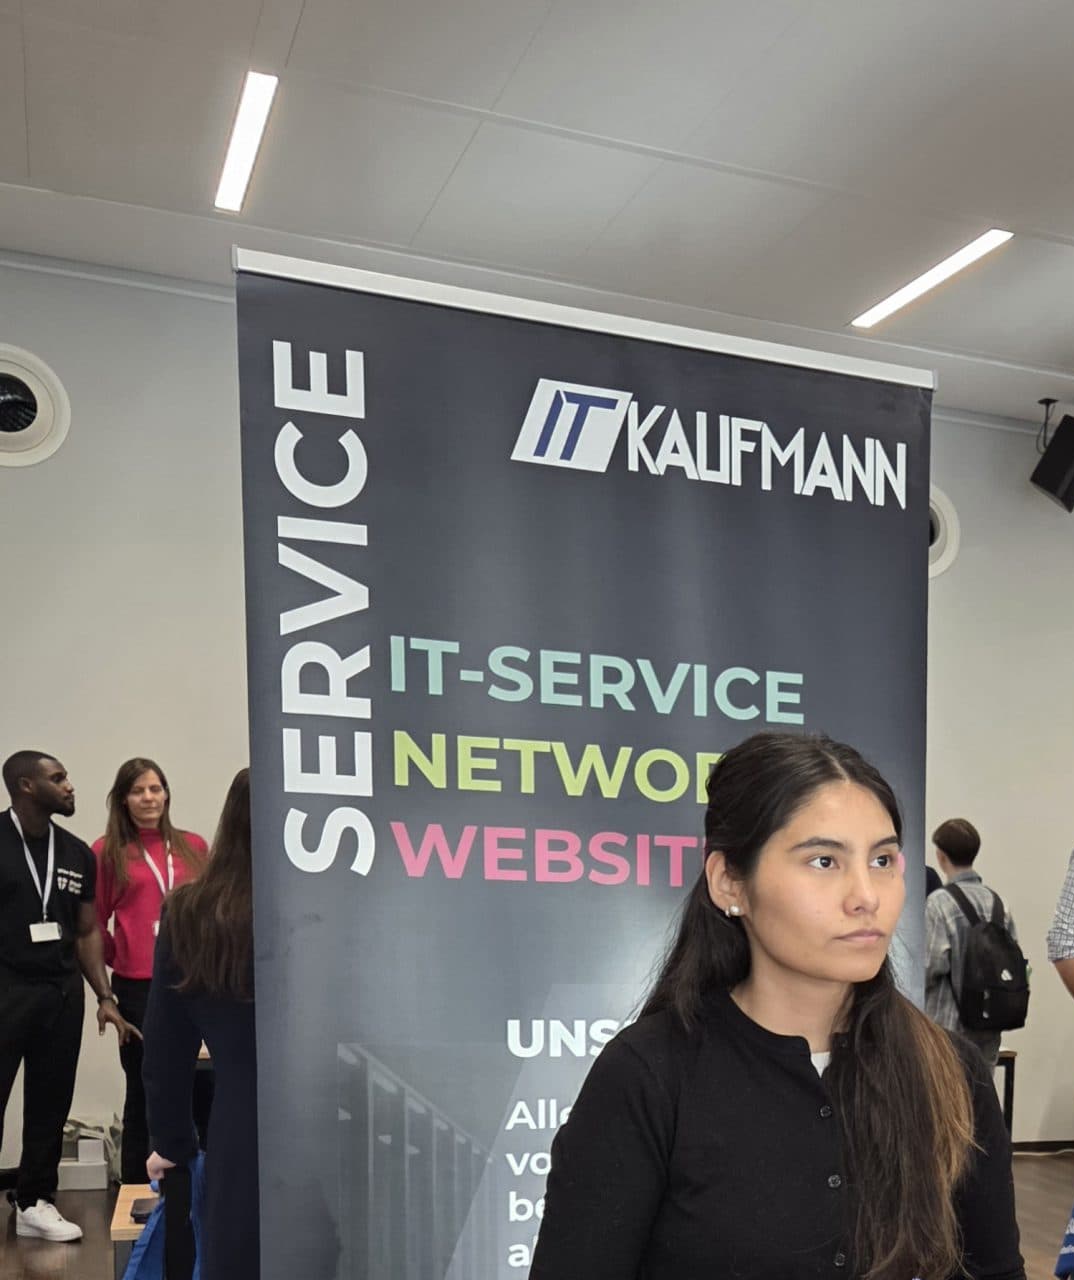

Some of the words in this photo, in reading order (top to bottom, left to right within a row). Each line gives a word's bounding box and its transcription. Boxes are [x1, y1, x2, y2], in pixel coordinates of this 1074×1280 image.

[627, 401, 906, 510] KAUFMANN
[272, 340, 375, 877] SERVICE
[390, 635, 804, 725] IT-SERVICE
